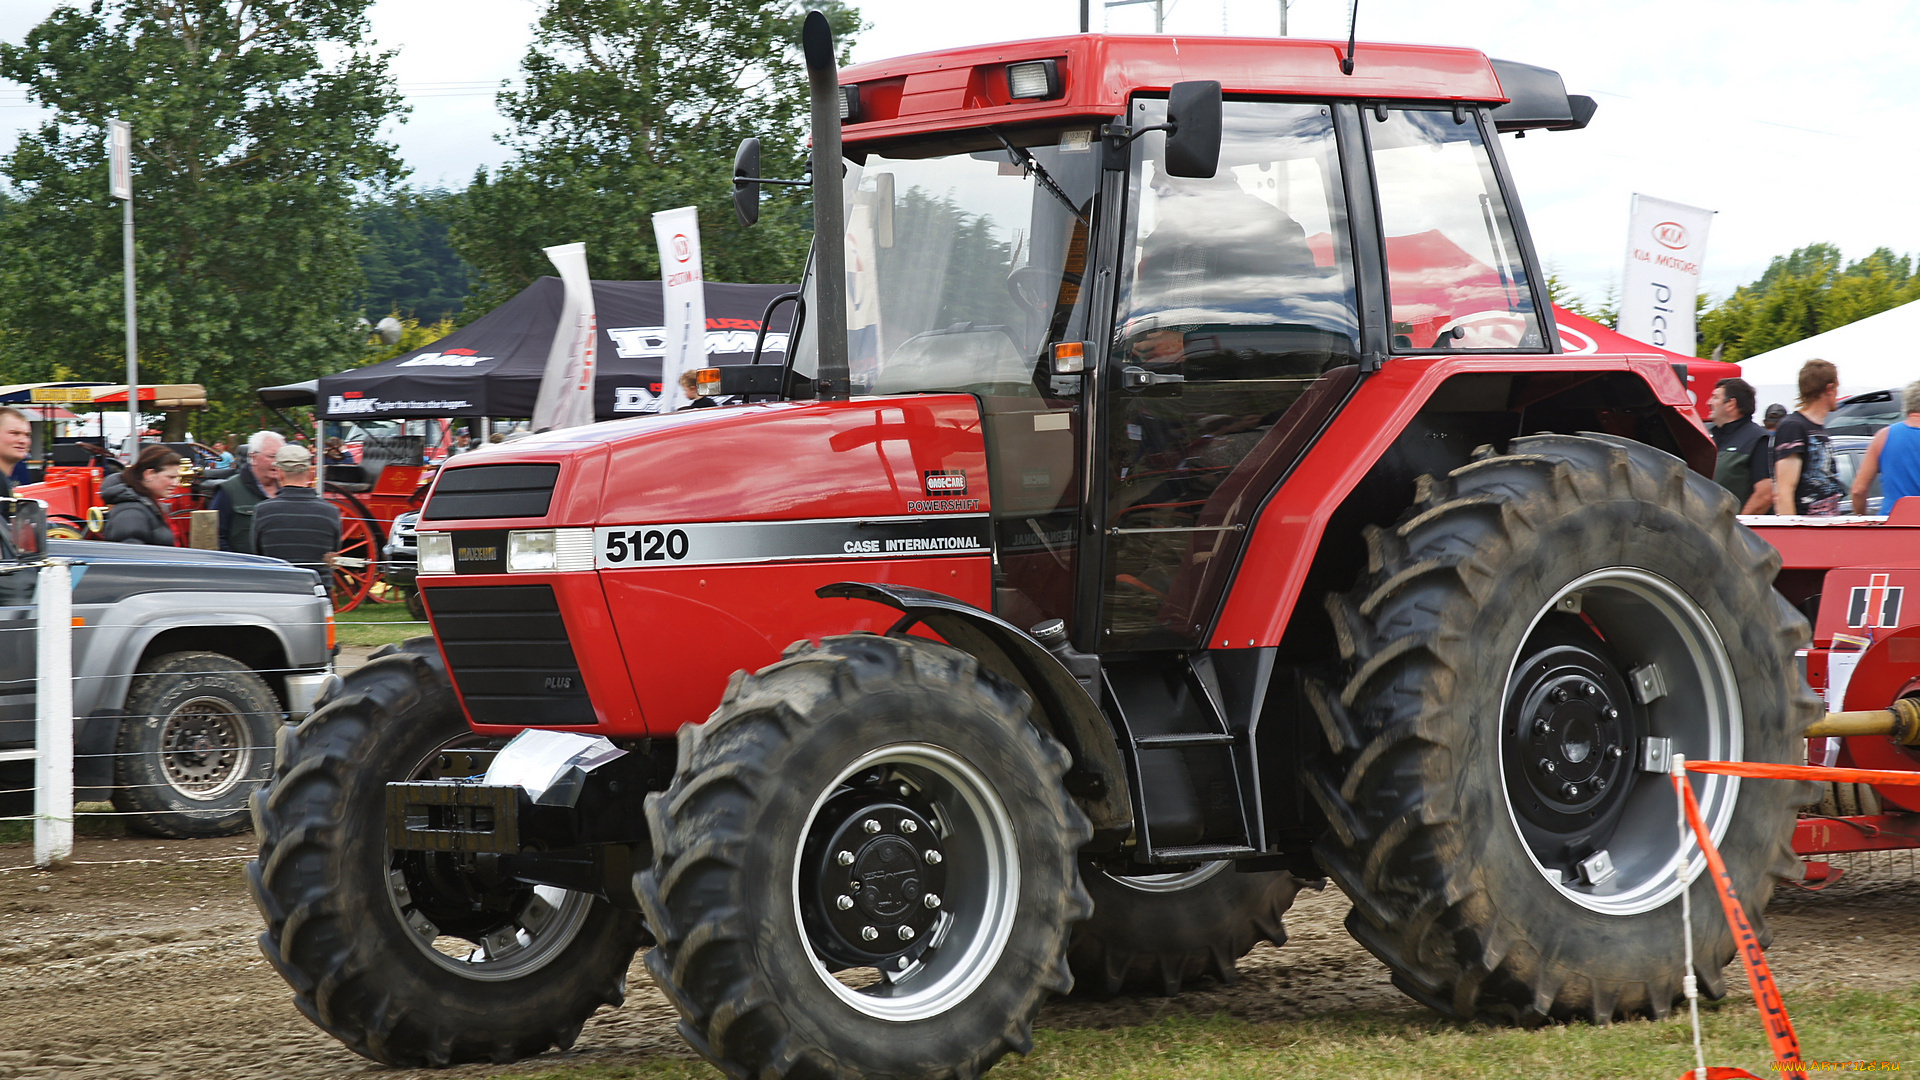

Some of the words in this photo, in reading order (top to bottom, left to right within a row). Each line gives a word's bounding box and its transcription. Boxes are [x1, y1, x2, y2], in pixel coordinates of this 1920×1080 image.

[1633, 248, 1651, 263] KIA
[1654, 253, 1699, 276] MOTORS
[907, 499, 980, 512] POWERSHIFT
[605, 528, 690, 563] 5120
[843, 540, 880, 554] CASE
[885, 536, 981, 552] INTERNATIONAL
[458, 547, 497, 562] MAXXUM
[544, 676, 572, 689] PLUS
